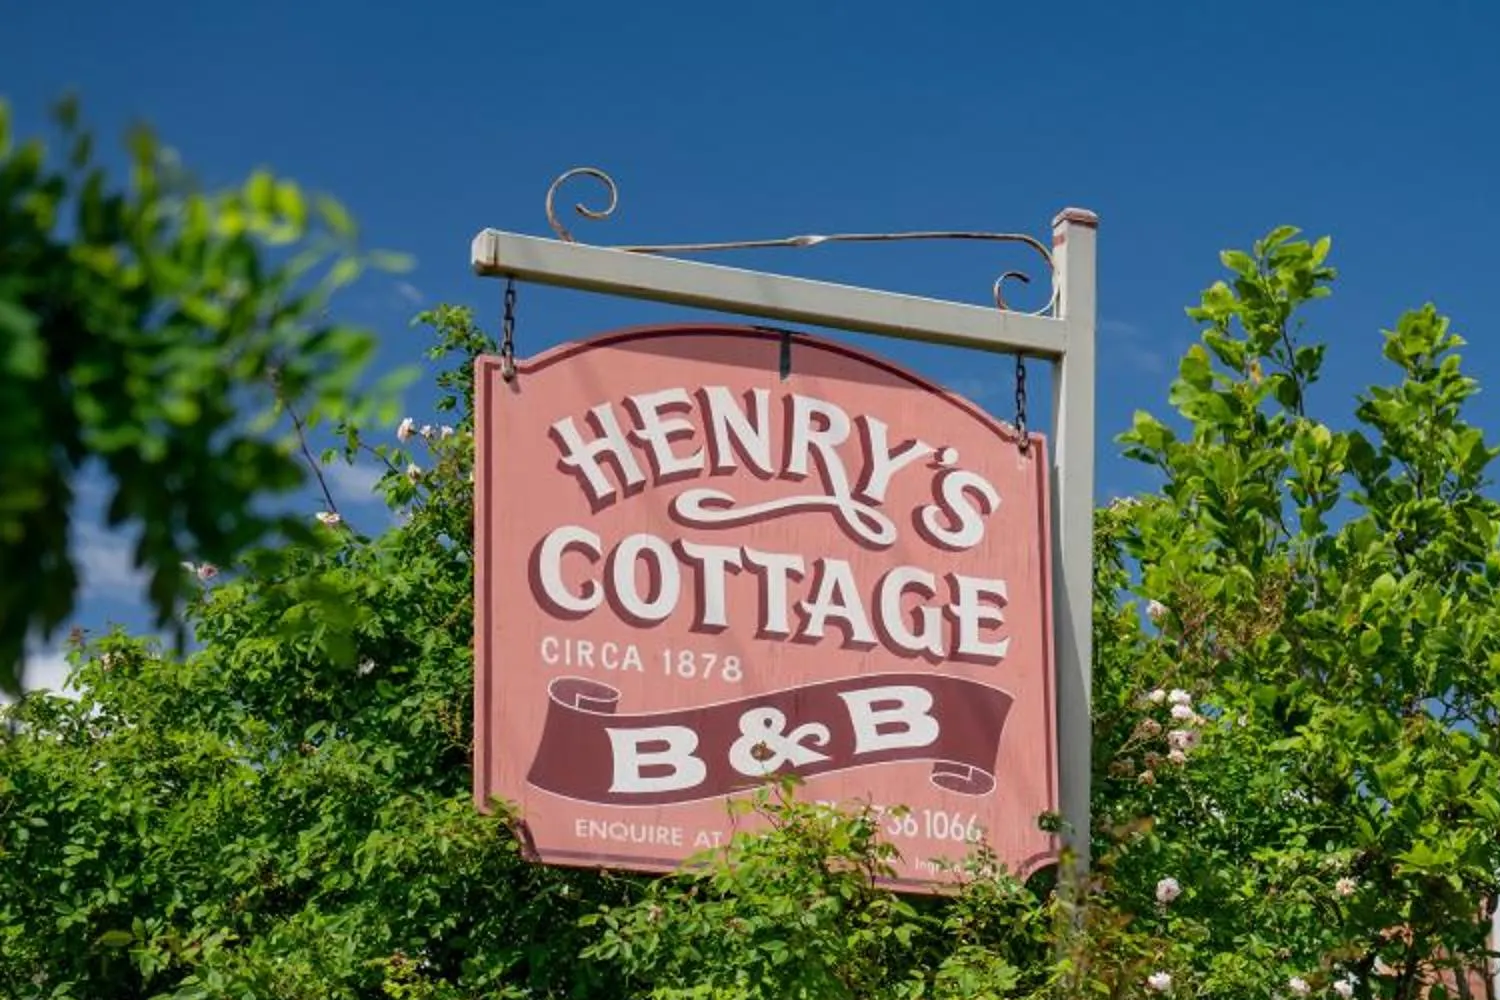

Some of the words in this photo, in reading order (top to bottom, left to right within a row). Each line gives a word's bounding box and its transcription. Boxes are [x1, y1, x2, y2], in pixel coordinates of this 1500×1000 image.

[549, 384, 1002, 549] HENRY'S
[529, 525, 1010, 664] COTTAGE
[540, 636, 644, 673] CIRCA
[662, 649, 743, 683] 1878
[604, 725, 707, 793] B
[729, 707, 832, 776] &
[837, 686, 940, 755] B
[575, 818, 683, 847] ENQUIRE
[693, 830, 723, 849] AT
